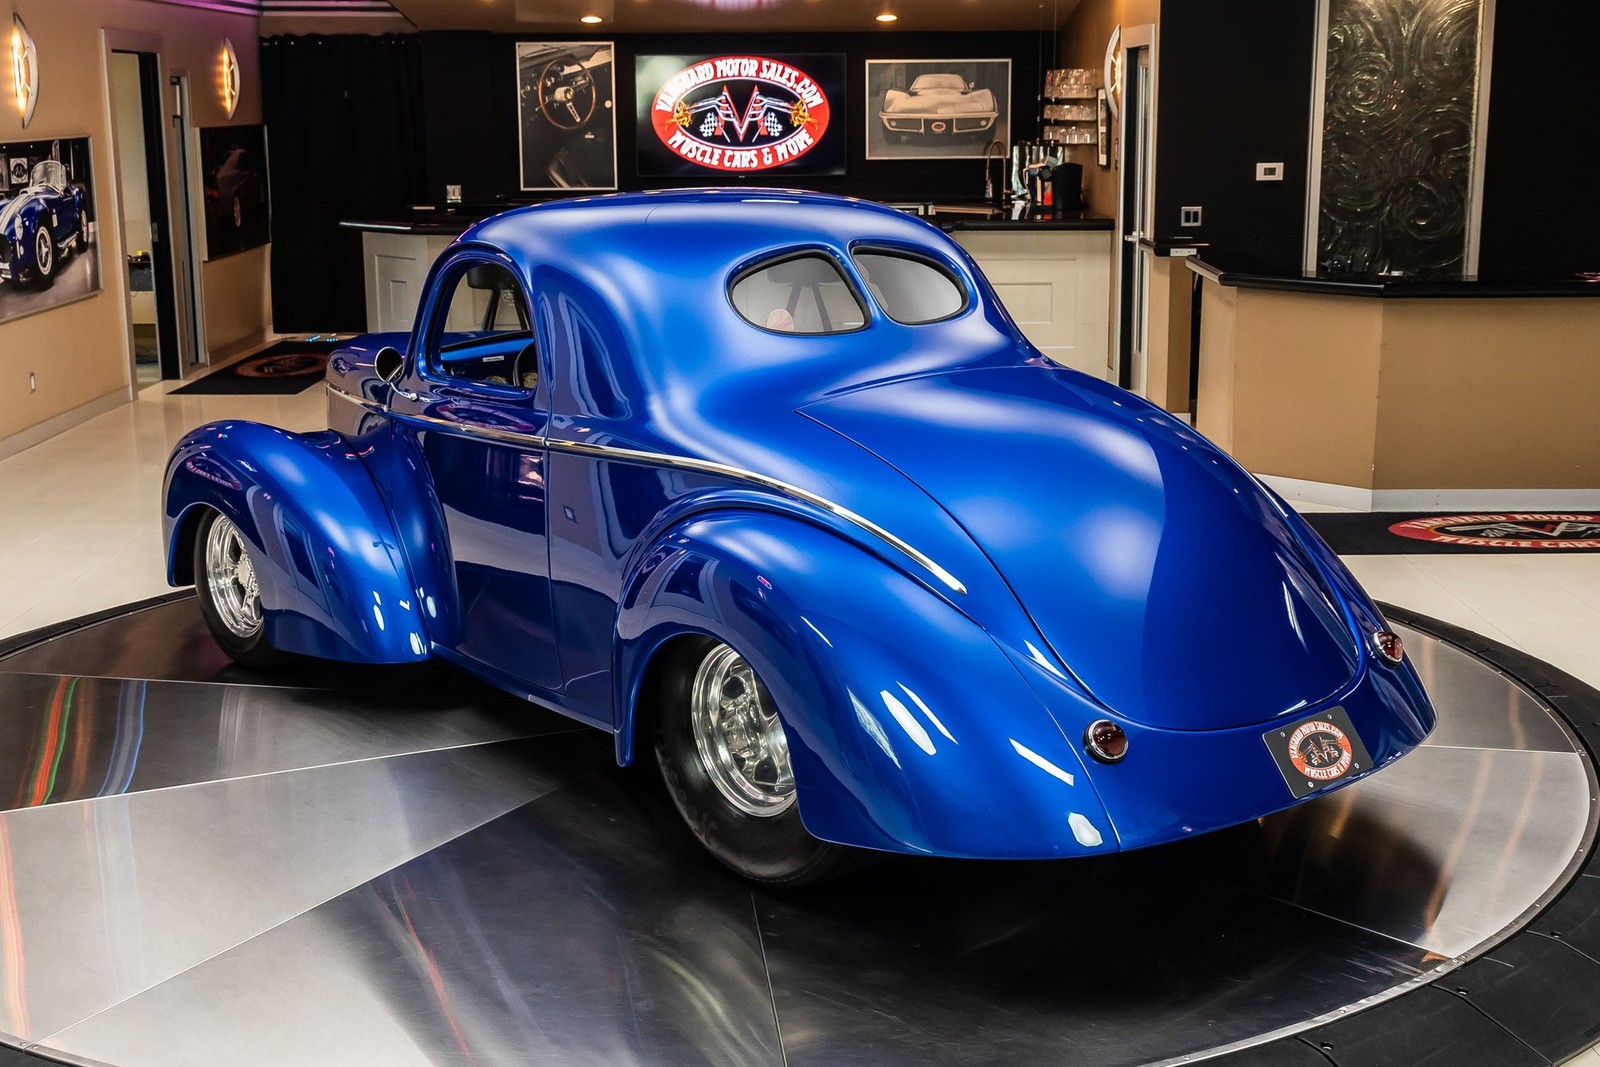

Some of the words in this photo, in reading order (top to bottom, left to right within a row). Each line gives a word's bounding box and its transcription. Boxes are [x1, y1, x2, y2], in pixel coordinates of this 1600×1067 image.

[656, 64, 714, 112] VAARD
[715, 58, 759, 78] MOTOR
[759, 59, 824, 108] SALES.COM
[667, 129, 721, 166] MUSCLE
[723, 150, 759, 168] CARS
[762, 149, 773, 166] &
[775, 128, 814, 162] MORE
[1430, 535, 1533, 548] MUSCLE
[1304, 767, 1328, 779] MUSCLE
